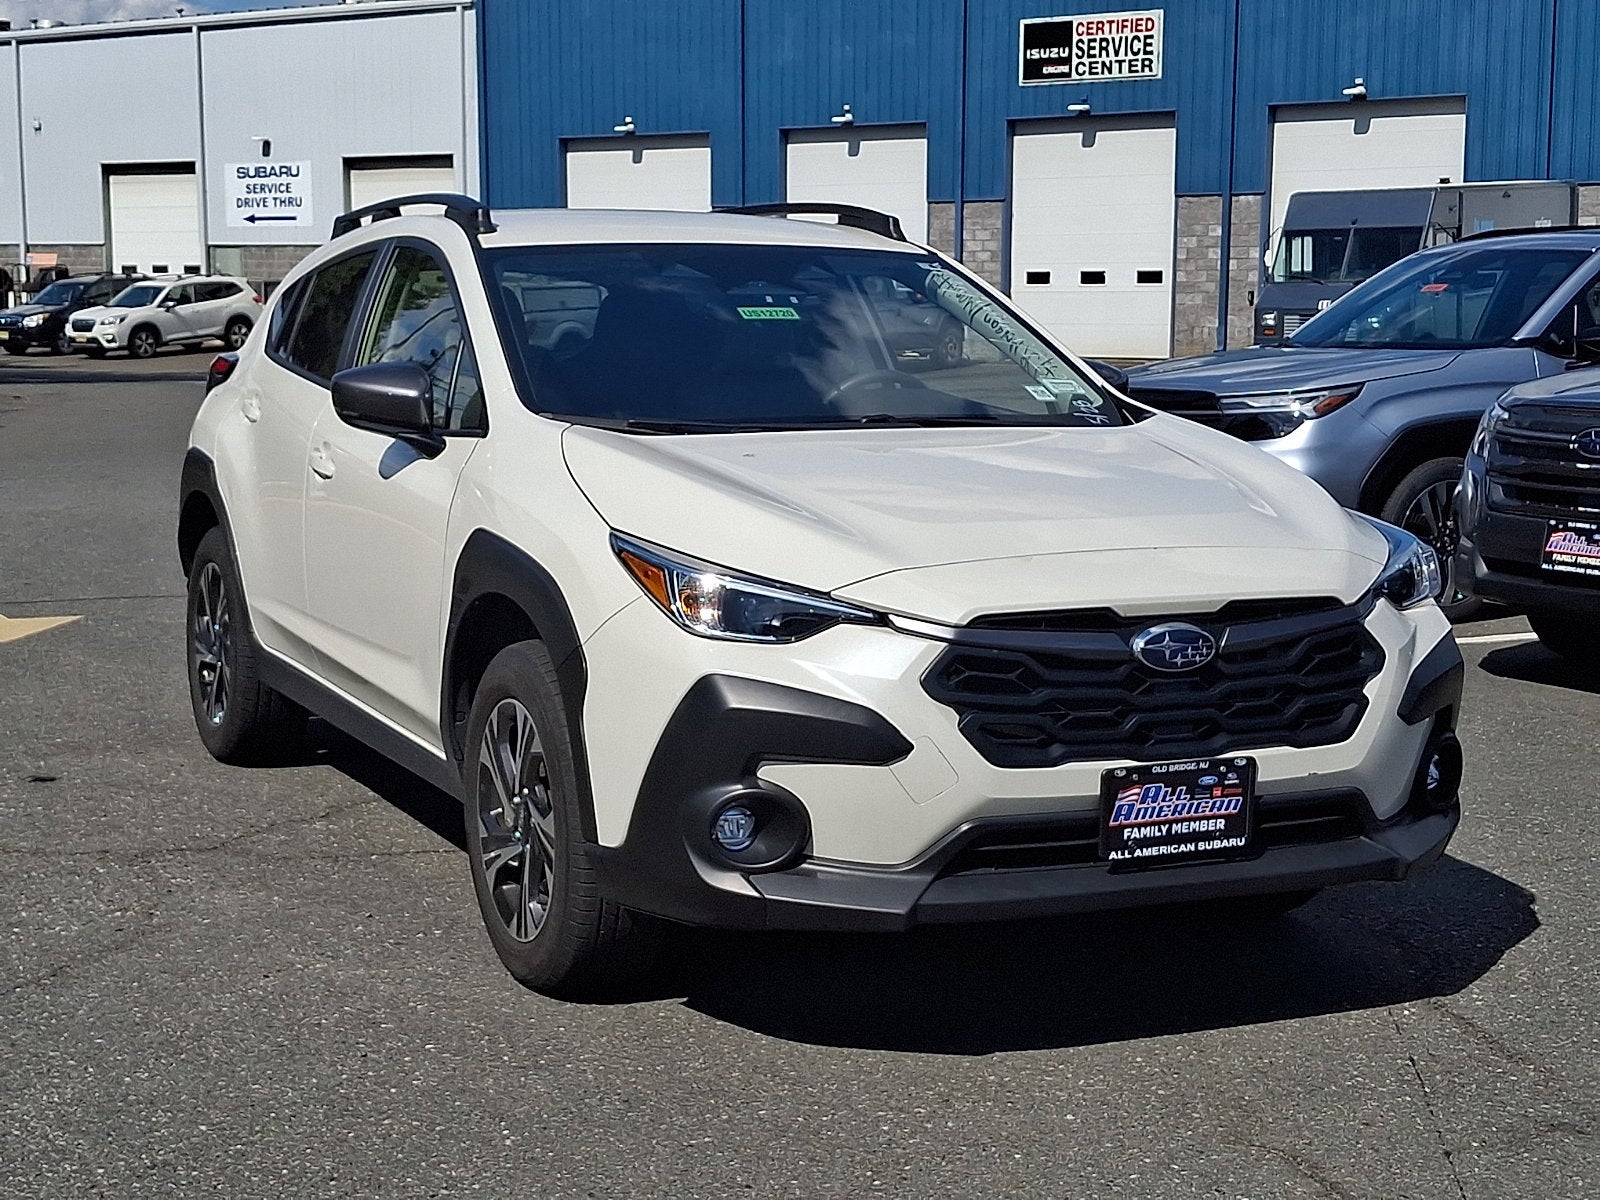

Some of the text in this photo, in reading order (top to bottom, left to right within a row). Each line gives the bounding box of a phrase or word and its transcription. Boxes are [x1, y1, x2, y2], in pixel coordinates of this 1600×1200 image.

[1075, 17, 1155, 36] CERTIFIED
[1026, 47, 1069, 59] ISUZU
[1075, 34, 1154, 60] SERVICE
[1075, 57, 1154, 76] CENTER
[236, 165, 300, 179] SUBARU
[245, 182, 292, 194] SERVICE
[236, 196, 303, 208] DRIVE THRU
[1152, 765, 1168, 773] OLD
[1200, 761, 1209, 769] NJ
[1138, 784, 1191, 805] ALL
[1123, 818, 1226, 841] FAMILY MEMBER
[1108, 836, 1246, 860] ALL AMERICAN SUBARU
